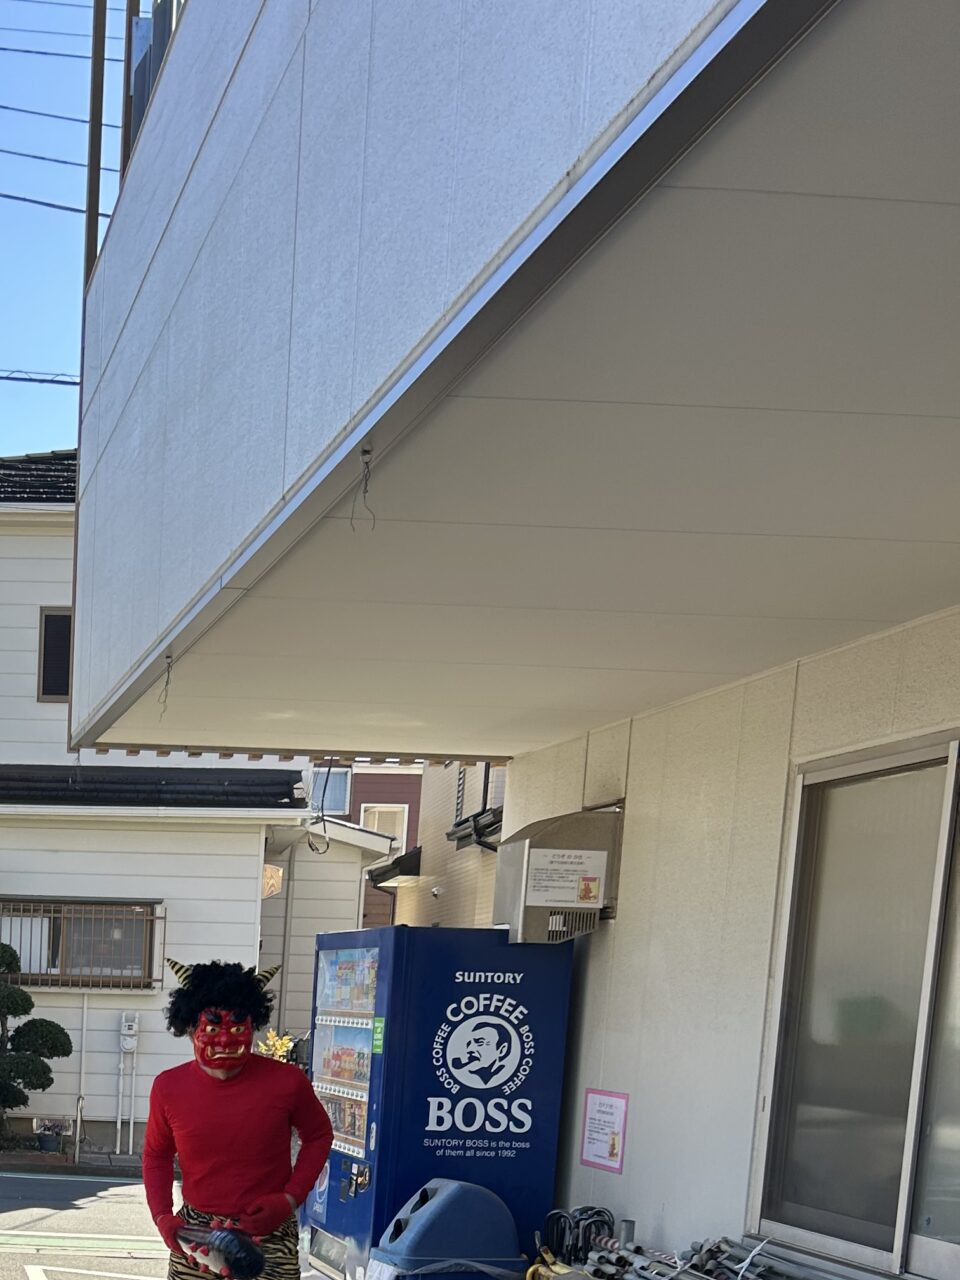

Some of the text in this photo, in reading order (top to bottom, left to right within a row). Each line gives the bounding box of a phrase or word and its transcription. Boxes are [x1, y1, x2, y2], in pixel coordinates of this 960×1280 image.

[455, 971, 524, 984] SUNTORY
[446, 993, 529, 1025] COFFEE
[432, 1022, 461, 1095] BOSS COFFEE
[501, 1024, 535, 1096] BOSS COFFEE
[425, 1097, 533, 1133] BOSS
[423, 1138, 530, 1149] SUNTORY BOSS is the boss
[436, 1149, 516, 1158] of them all since 1992
